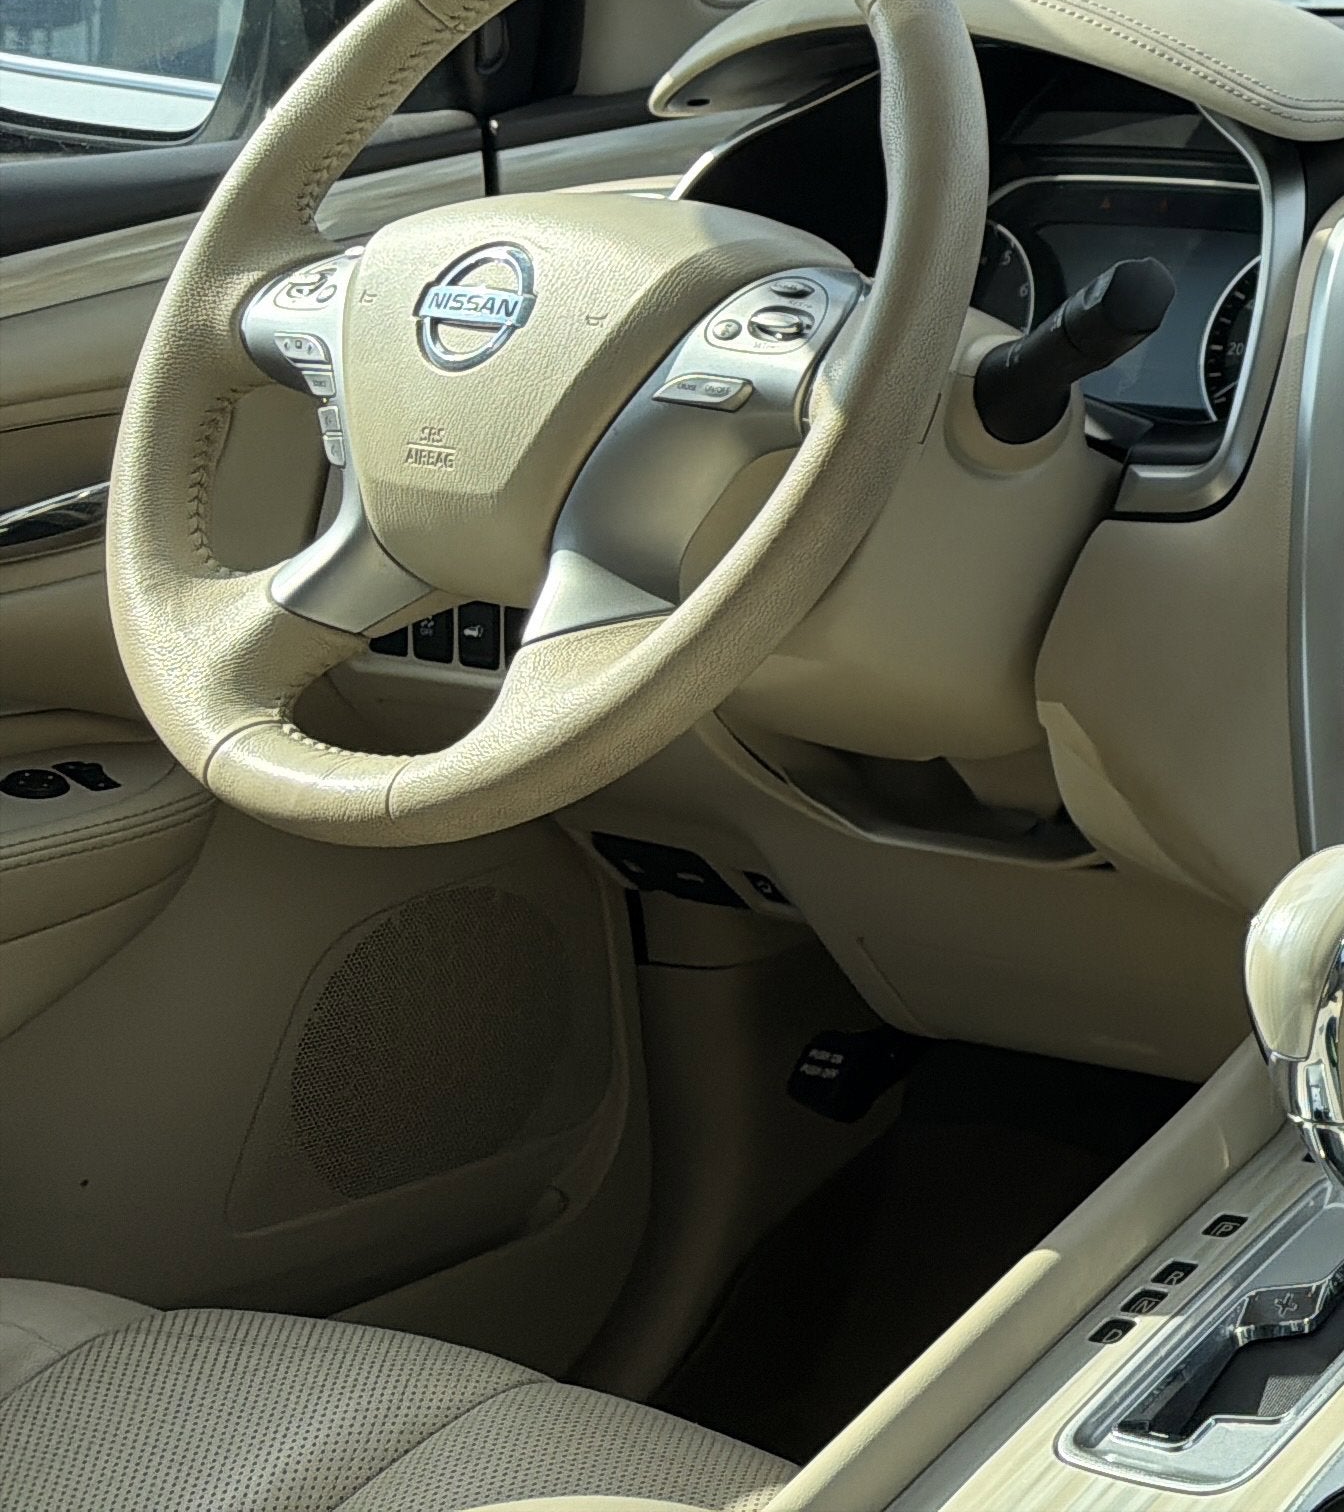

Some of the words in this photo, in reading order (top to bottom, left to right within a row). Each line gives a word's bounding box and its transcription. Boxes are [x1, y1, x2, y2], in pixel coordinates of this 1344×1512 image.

[428, 291, 520, 318] NISSAN
[420, 425, 446, 443] SRS
[403, 446, 455, 470] AIRBAG
[1164, 1270, 1185, 1286] R
[1102, 1328, 1123, 1343] D
